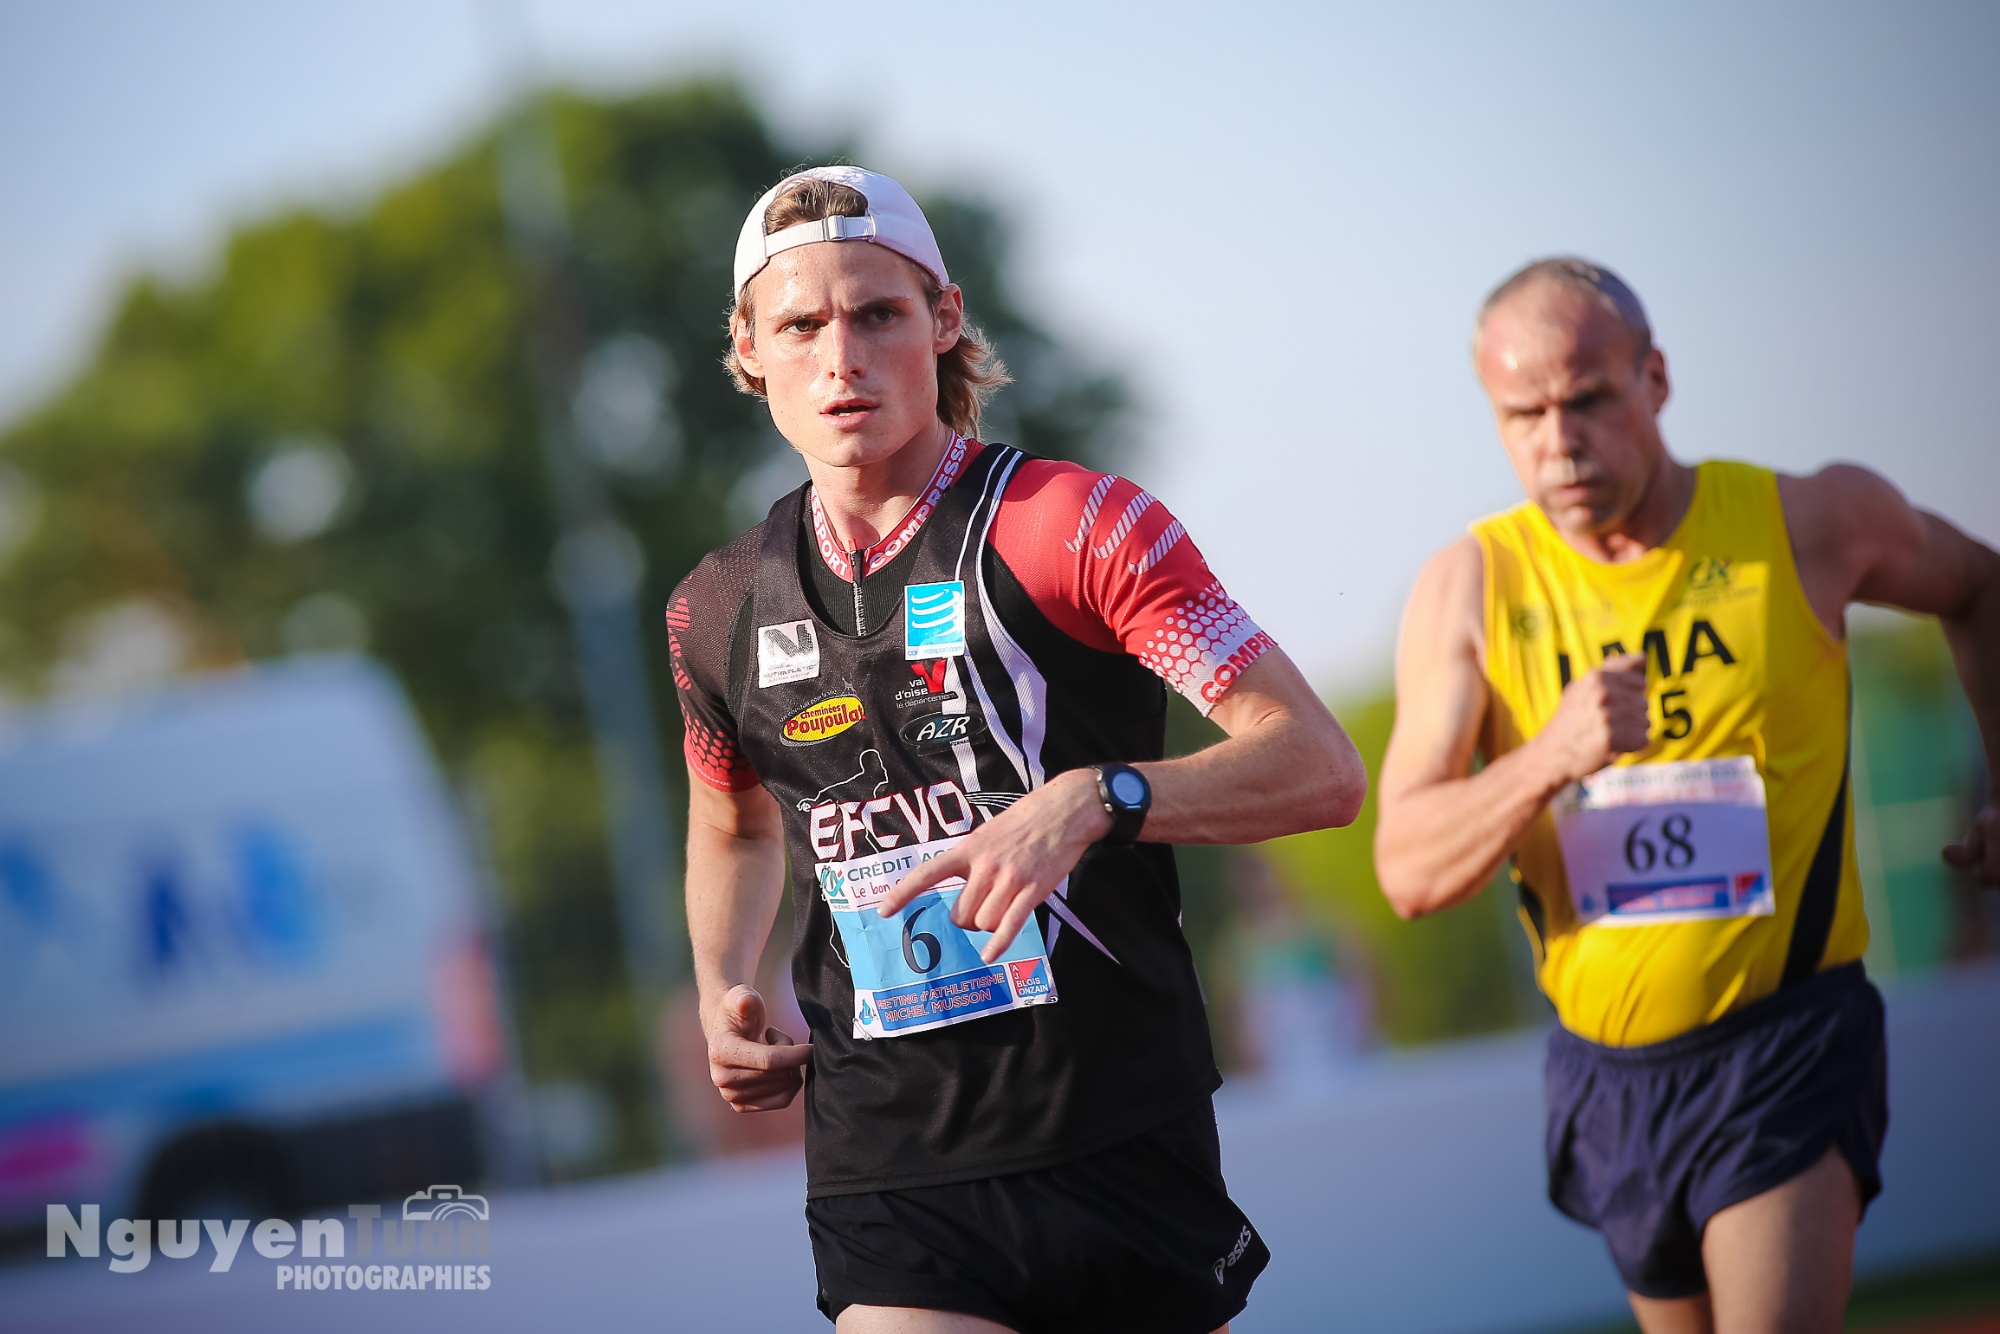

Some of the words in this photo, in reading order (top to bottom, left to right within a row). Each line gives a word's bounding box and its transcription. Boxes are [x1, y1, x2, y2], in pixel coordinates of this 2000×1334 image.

[894, 686, 929, 701] d'oise
[909, 676, 926, 688] val
[785, 703, 867, 736] Poujoulat
[801, 704, 842, 719] cheminées
[916, 715, 971, 742] AZR
[809, 780, 974, 861] EFCVO
[1623, 812, 1696, 874] 68
[847, 855, 913, 882] CRÉDIT
[851, 885, 866, 899] Le
[869, 881, 890, 895] bon
[902, 905, 942, 975] 6
[1016, 977, 1041, 988] BLOIS
[1018, 984, 1049, 996] ONZAIN
[884, 1003, 930, 1022] MICHEL
[931, 989, 992, 1013] MUSSON
[1227, 1225, 1252, 1267] asics
